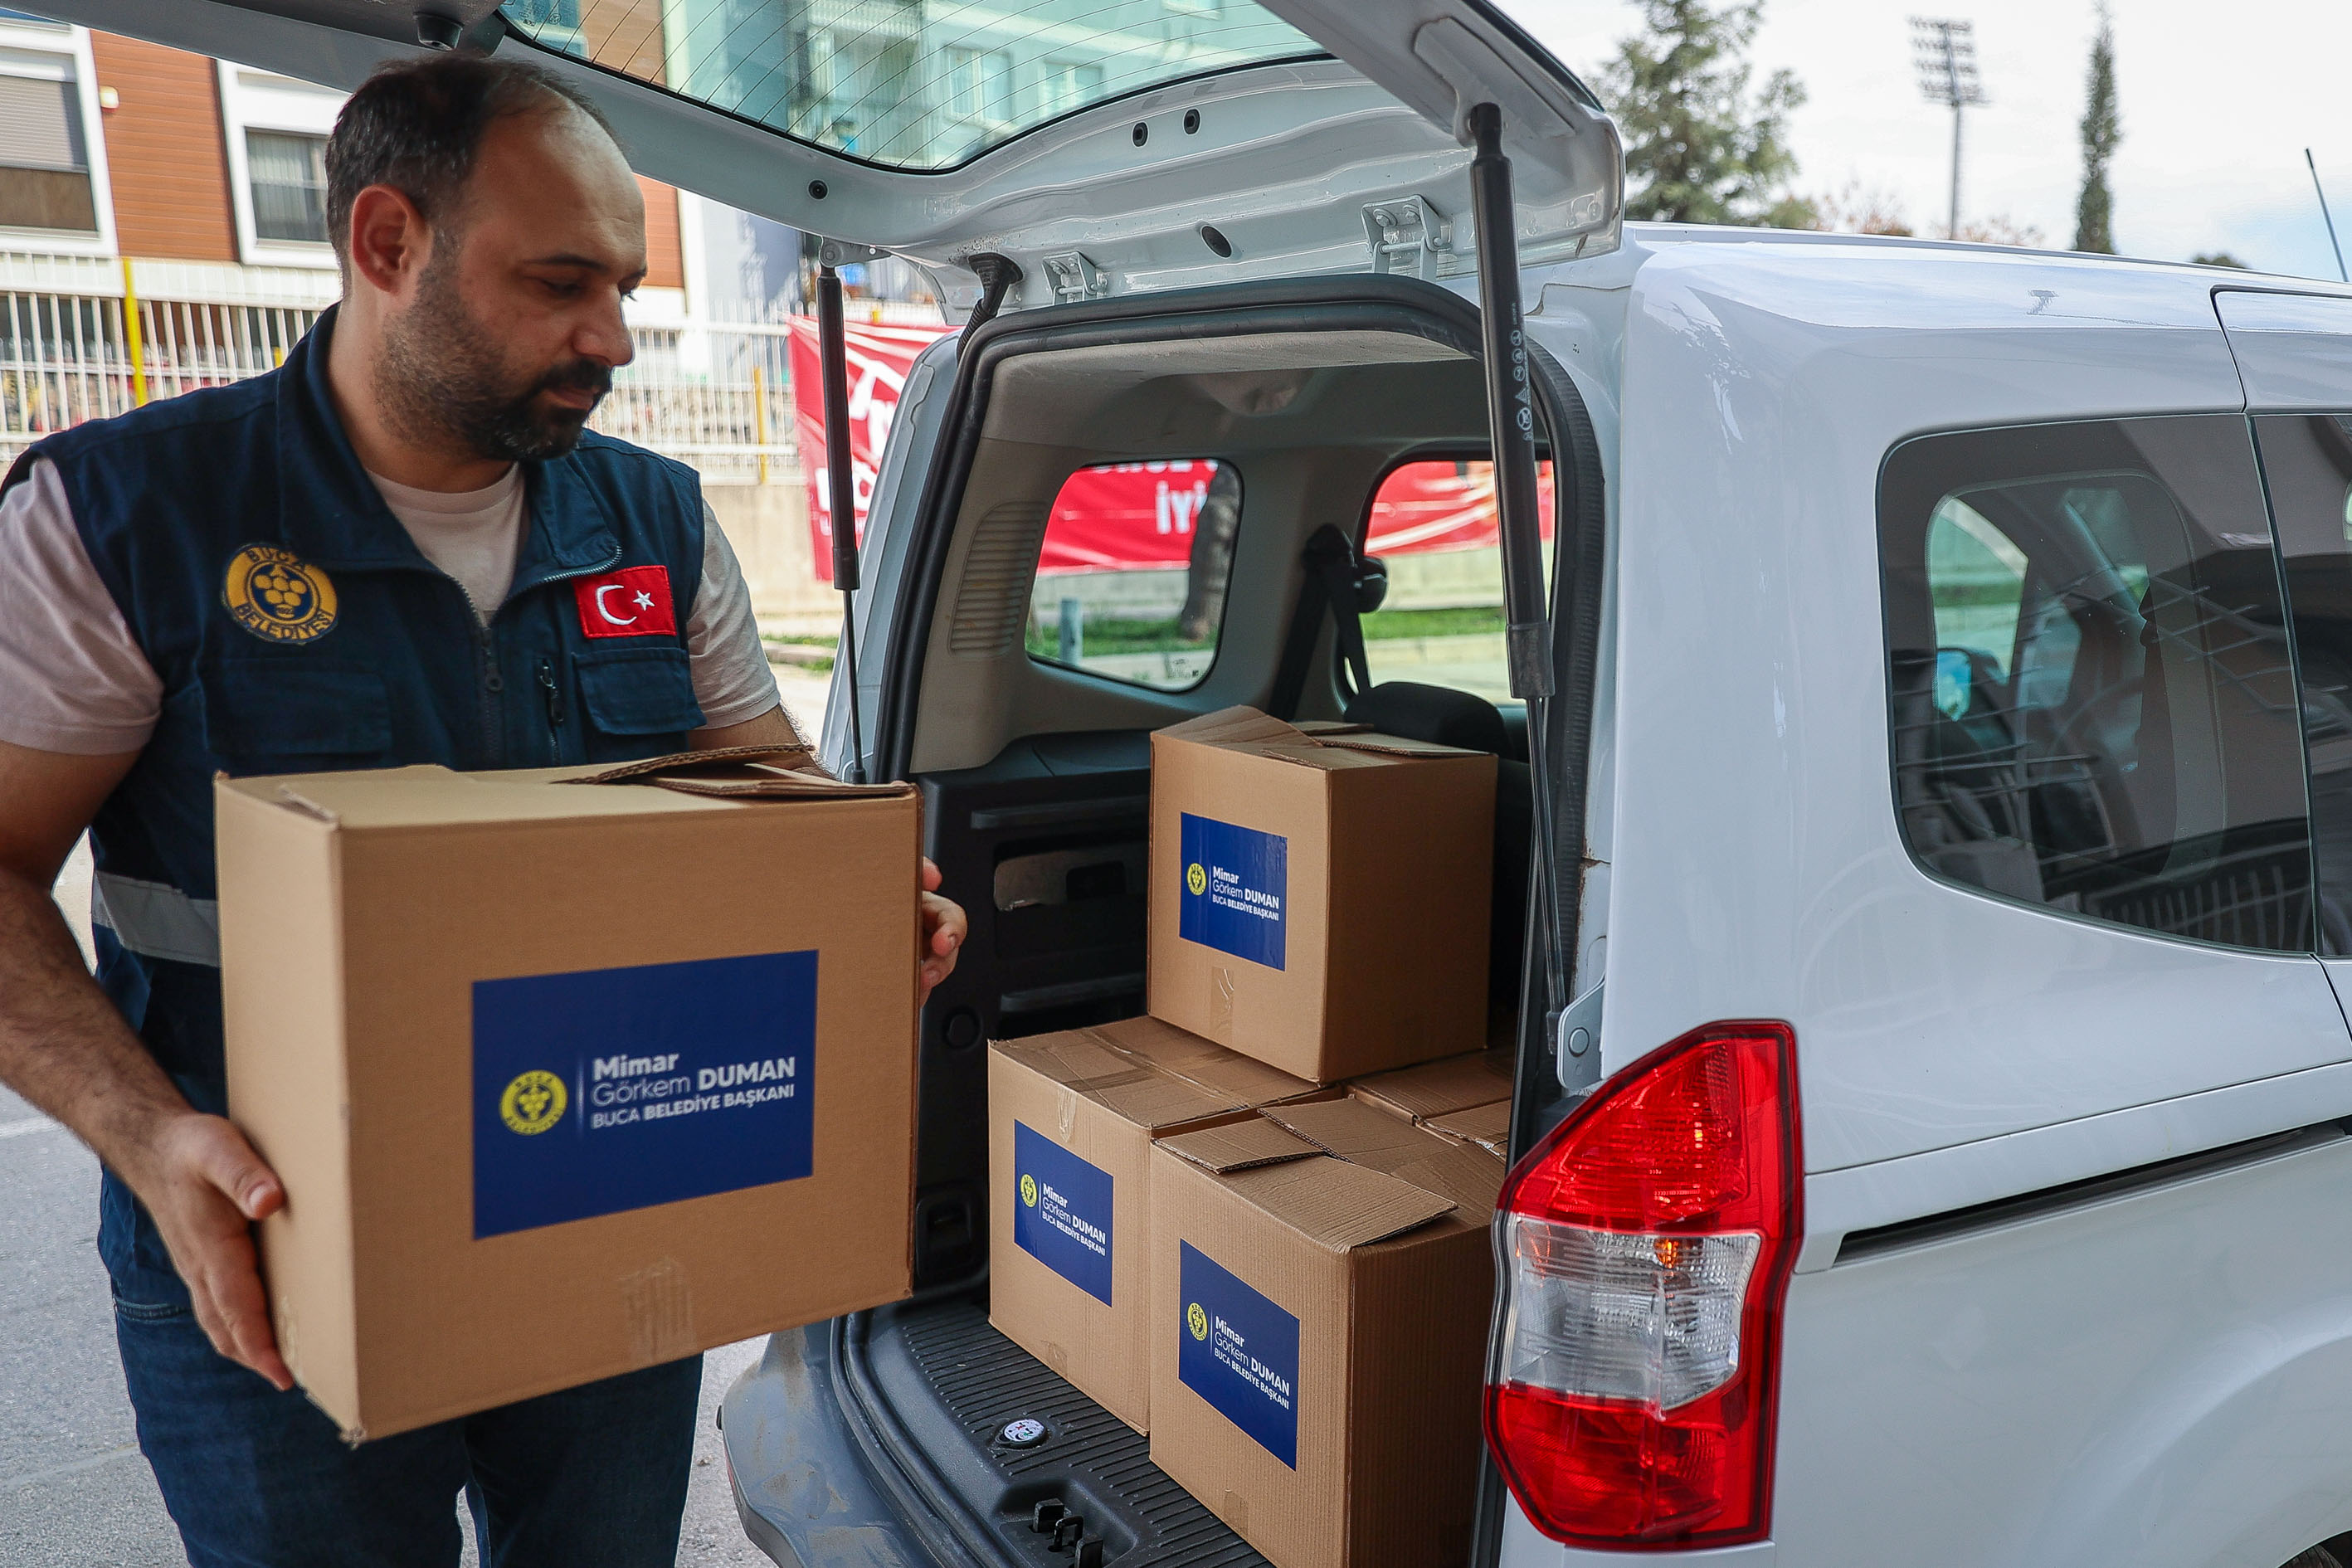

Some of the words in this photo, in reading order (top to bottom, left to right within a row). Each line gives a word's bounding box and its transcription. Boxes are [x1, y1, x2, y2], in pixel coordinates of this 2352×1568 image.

[1213, 865, 1239, 884] Mimar
[1212, 894, 1227, 906] BUCA
[1228, 898, 1253, 913] BELEDİYE
[1254, 906, 1279, 921] BAŞKANI
[1213, 879, 1243, 898] Görkem
[1244, 888, 1279, 909] DUMAN
[591, 1076, 691, 1107] Görkem
[697, 1056, 796, 1091] DUMAN
[593, 1053, 680, 1080] Mimar
[591, 1108, 641, 1129] BUCA
[643, 1093, 721, 1121] BELEDİYE
[723, 1083, 795, 1108] BAŞKANI
[1043, 1183, 1068, 1208] Mimar
[1042, 1210, 1056, 1225] BUCA
[1042, 1196, 1071, 1224] Görkem
[1072, 1214, 1106, 1244] DUMAN
[1215, 1316, 1244, 1346] Mimar
[1215, 1332, 1249, 1366] Görkem
[1251, 1356, 1289, 1396] DUMAN
[1215, 1347, 1230, 1366] BUCA
[1231, 1360, 1259, 1388] BELEDİYE
[1260, 1381, 1289, 1410] BAŞKANI
